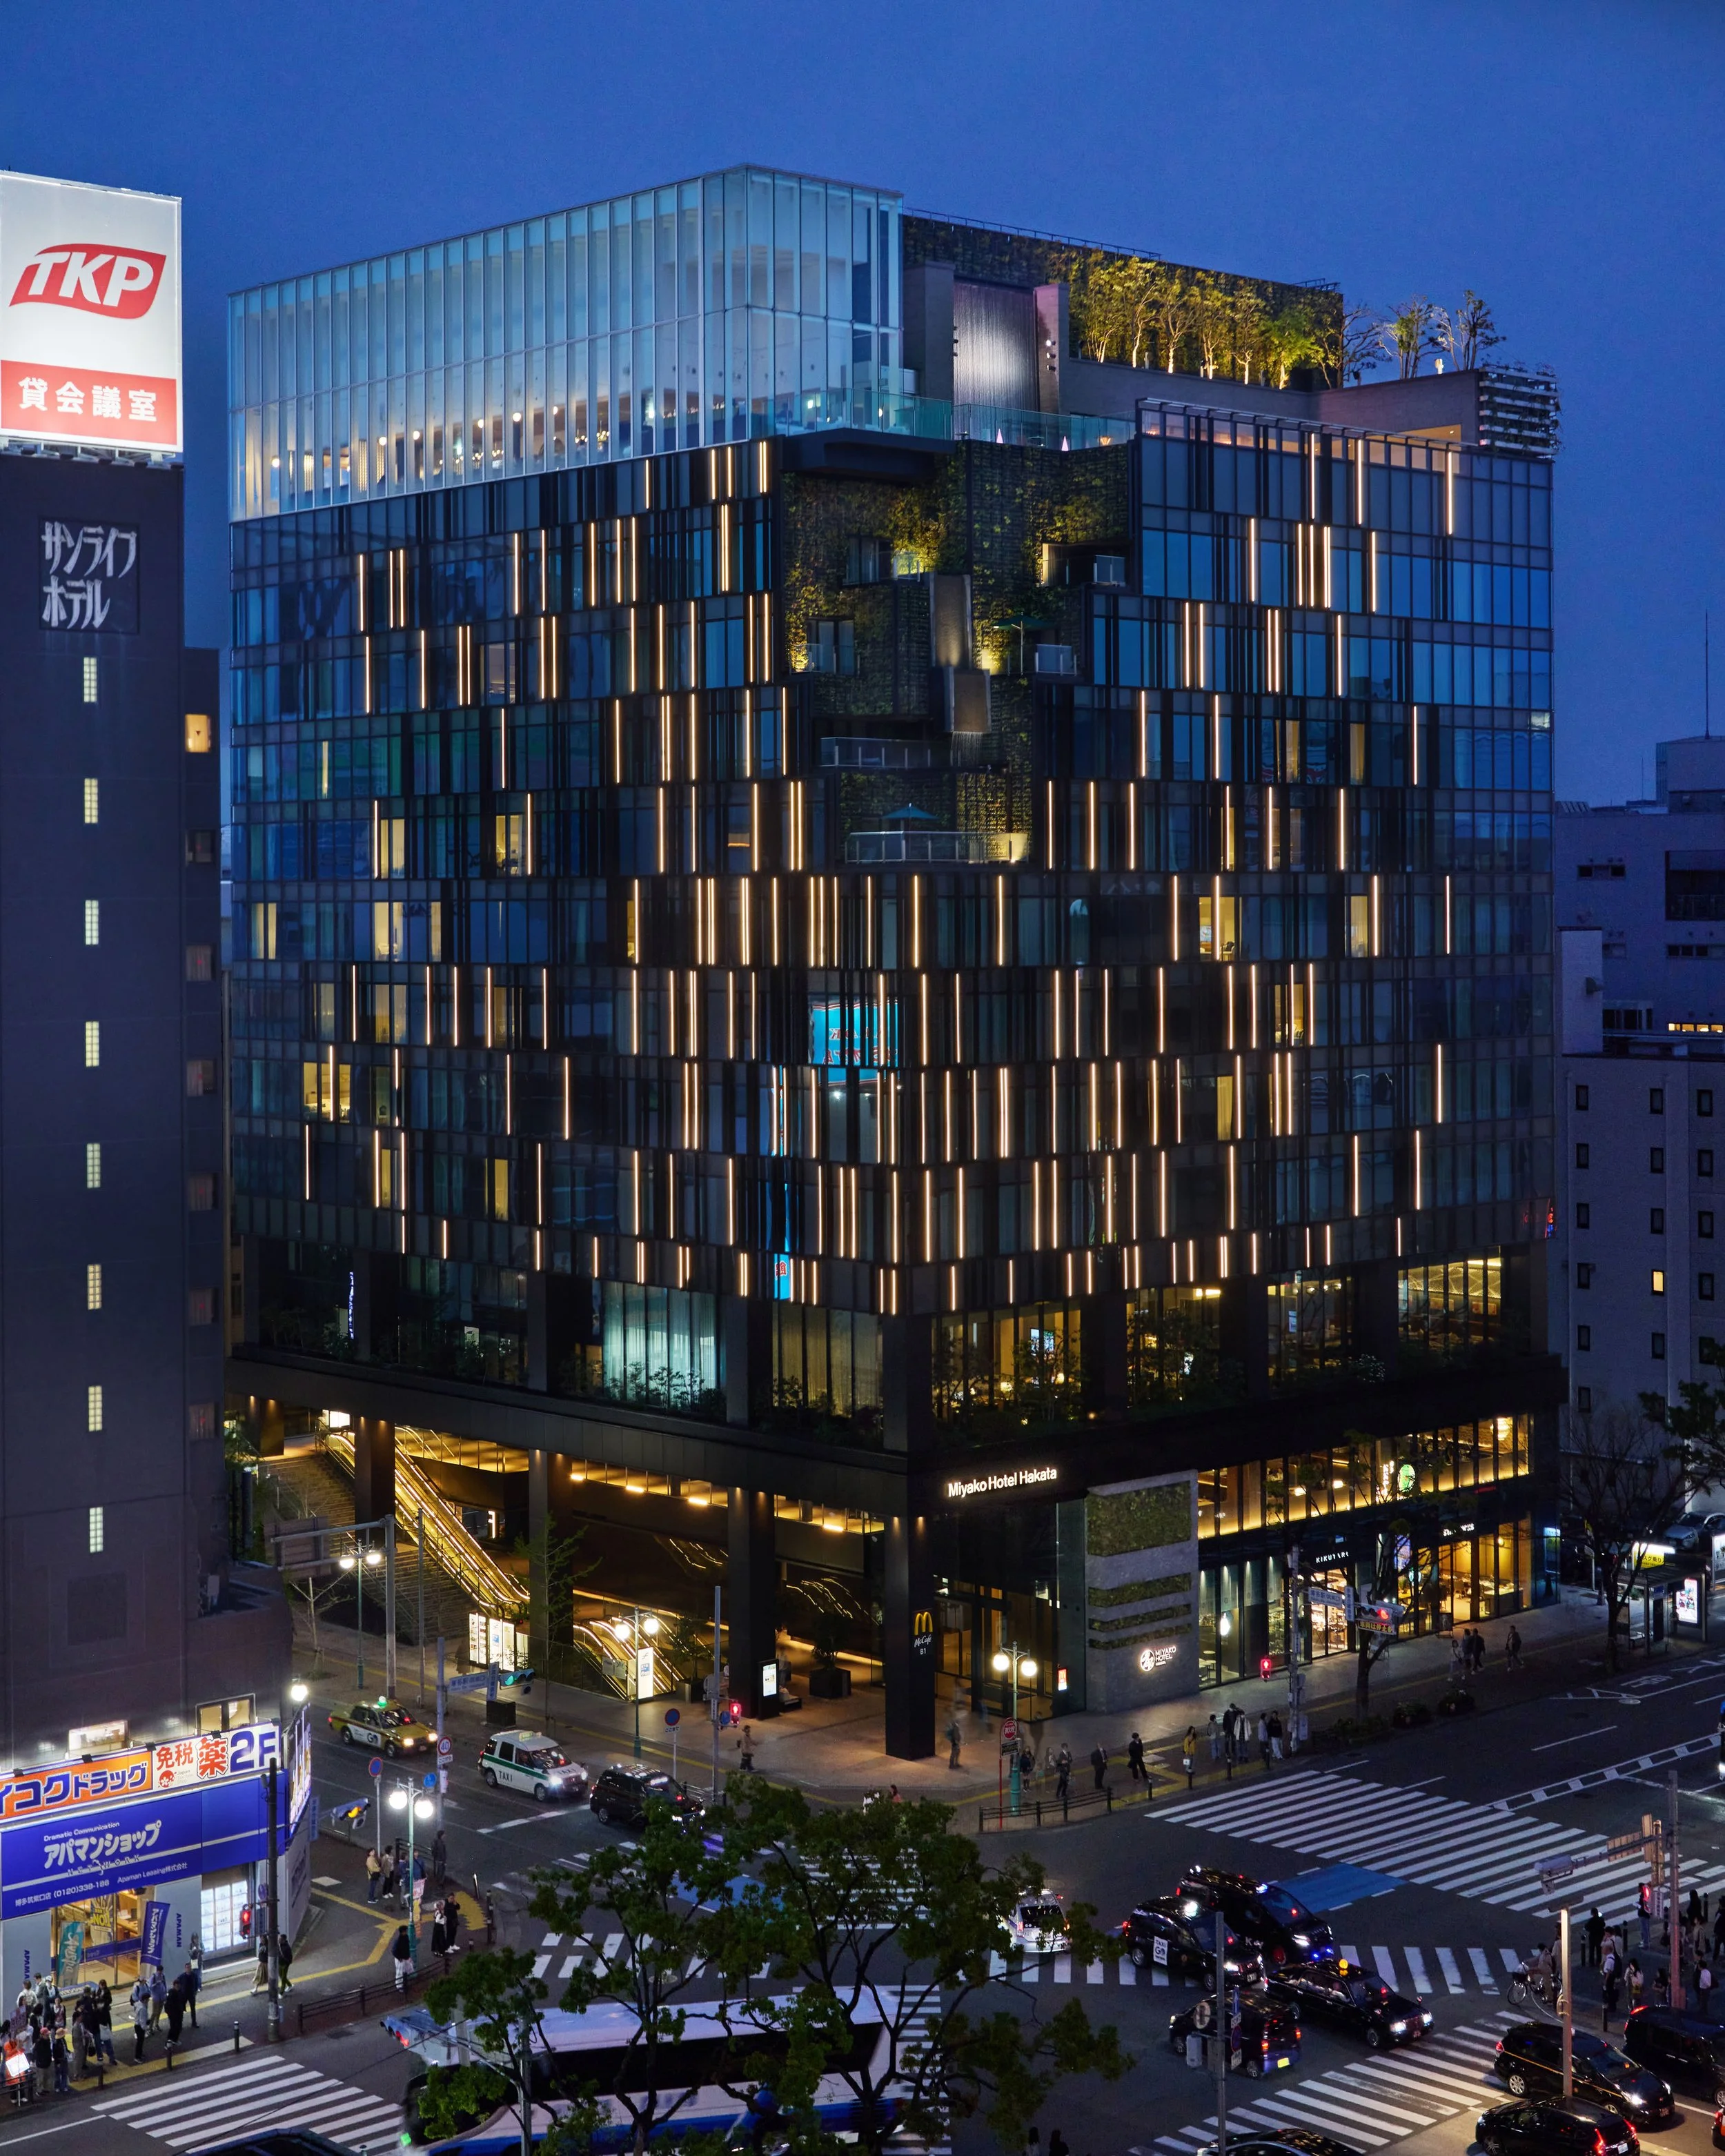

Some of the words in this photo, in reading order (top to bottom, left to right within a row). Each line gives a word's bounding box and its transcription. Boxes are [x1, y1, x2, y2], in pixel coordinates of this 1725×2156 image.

[27, 252, 154, 307] TKP
[19, 377, 157, 422] 貸会議室
[41, 521, 137, 579] サンライフ
[42, 575, 110, 629] ホテル
[948, 1479, 987, 1498] Miyako
[988, 1472, 1017, 1490] Hotel
[1020, 1467, 1057, 1485] Hakata
[1155, 1645, 1176, 1656] MIYAKO
[1155, 1654, 1173, 1662] HOTEL
[157, 1741, 194, 1771] 免税
[197, 1737, 228, 1778] 薬
[230, 1730, 276, 1773] 2F
[440, 1741, 449, 1751] 40
[499, 1770, 513, 1782] TAXI
[43, 1831, 72, 1841] Dramatic
[74, 1821, 120, 1836] Communication
[44, 1820, 162, 1869] アパマンショップ
[117, 1872, 142, 1884] Apaman
